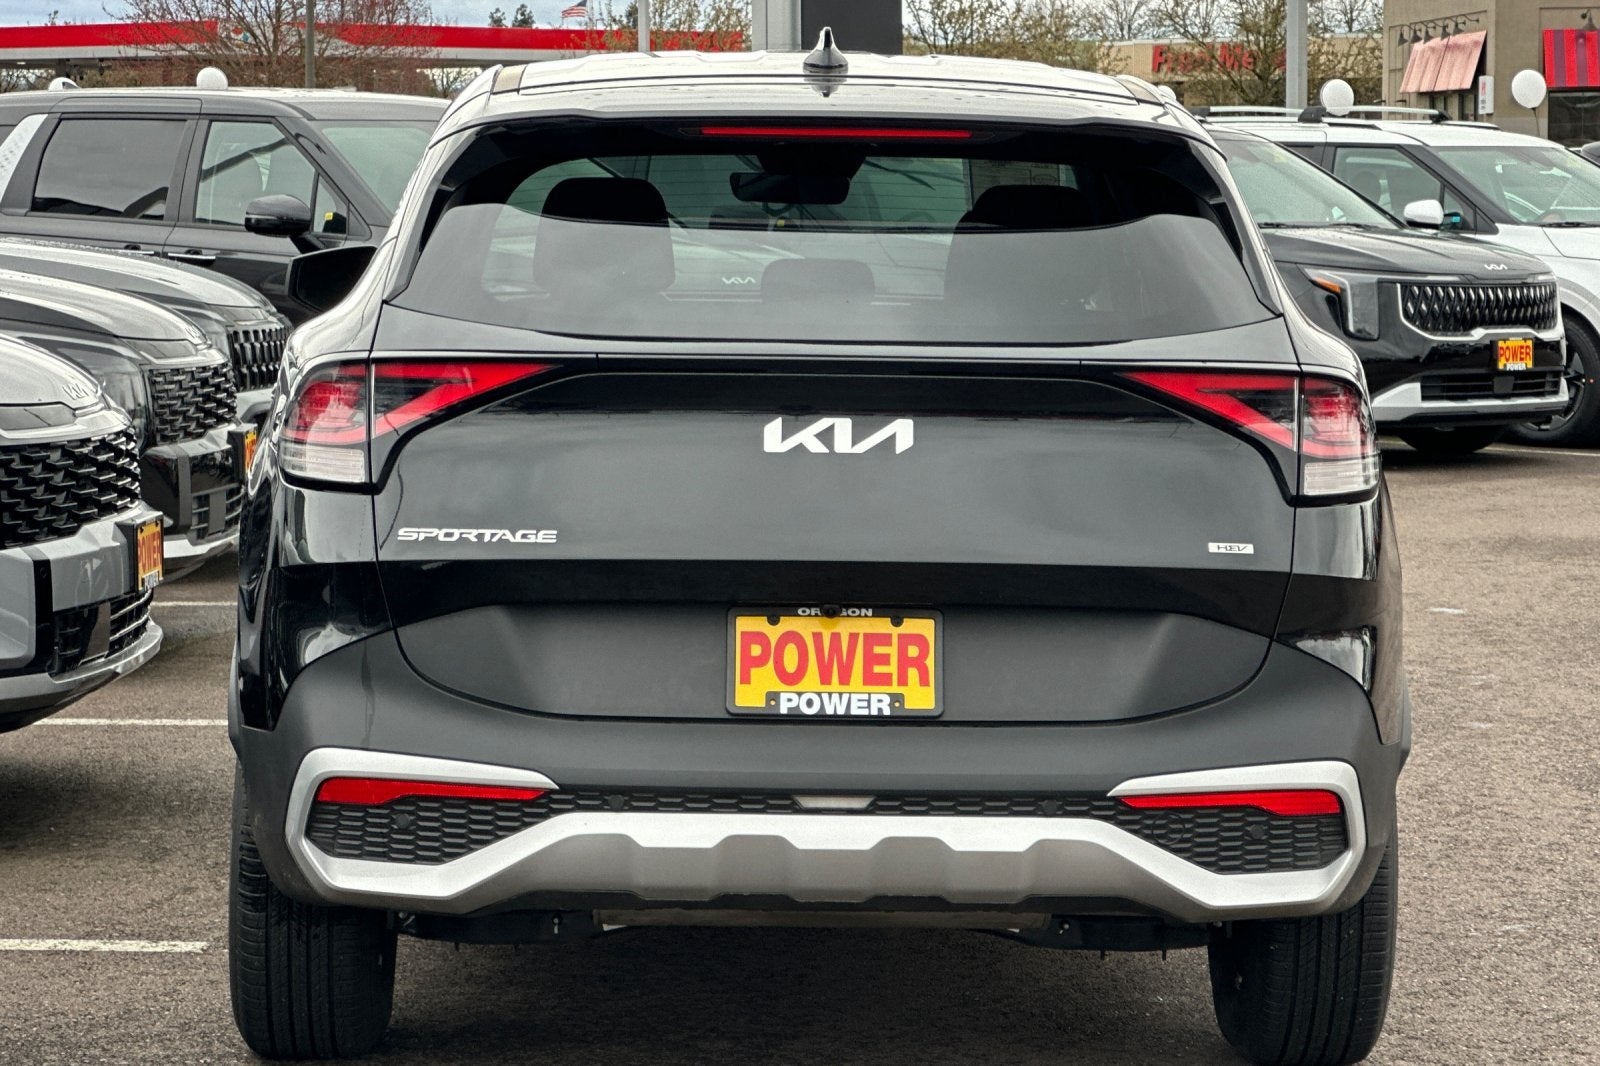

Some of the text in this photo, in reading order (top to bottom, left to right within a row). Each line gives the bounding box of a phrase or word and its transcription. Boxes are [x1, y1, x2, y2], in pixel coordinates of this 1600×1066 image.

[1499, 345, 1532, 362] POWER
[763, 416, 914, 455] KIA
[397, 527, 557, 544] SPORTAGE
[1217, 544, 1248, 553] HEV
[740, 630, 930, 687] POWER
[779, 692, 891, 715] POWER
